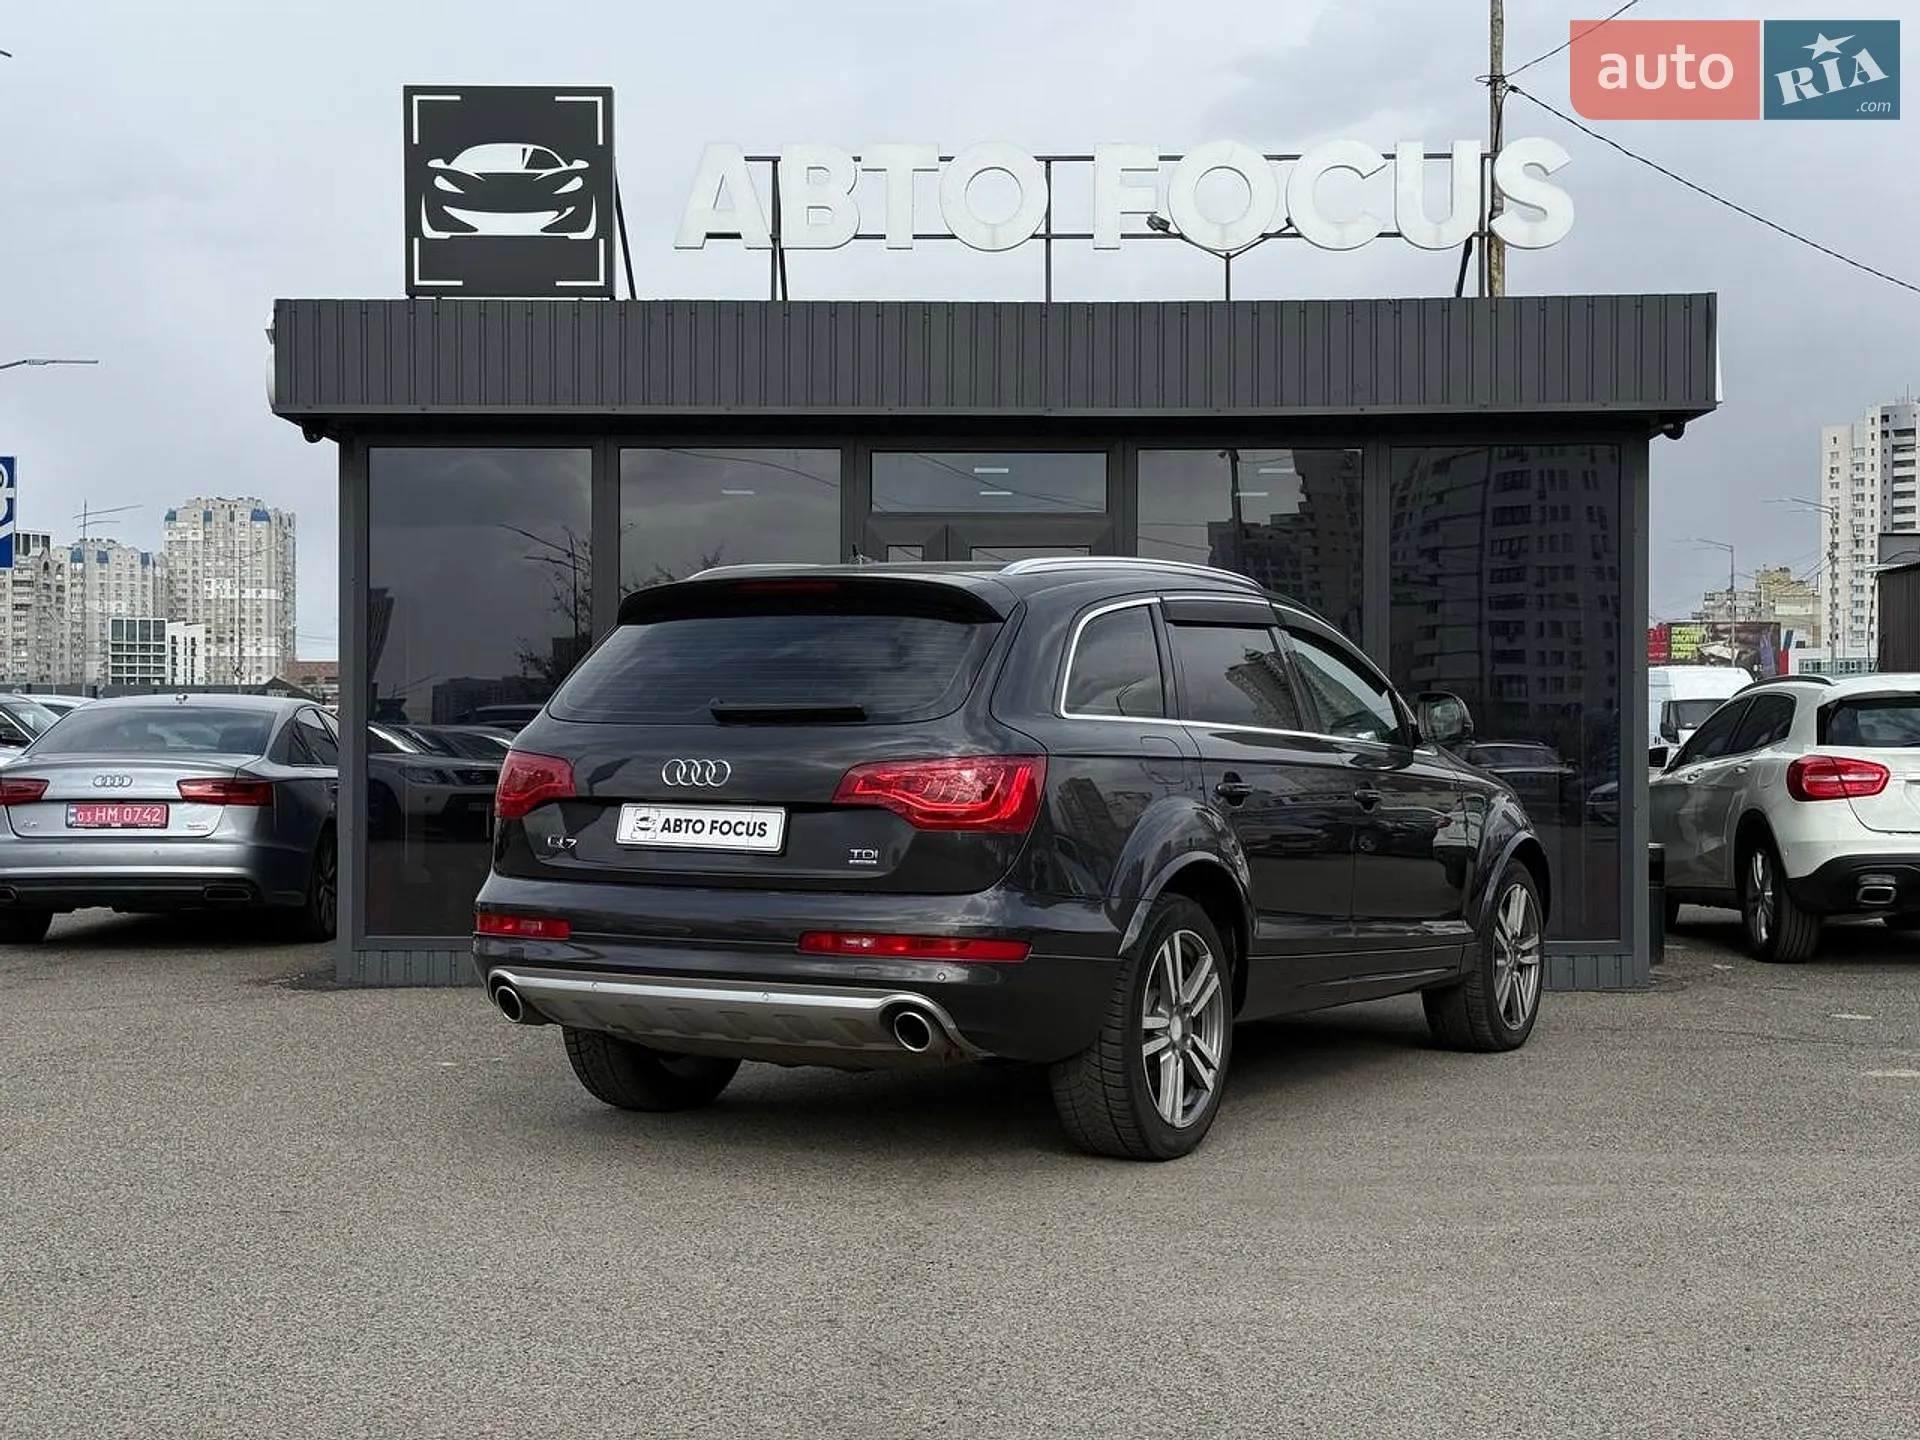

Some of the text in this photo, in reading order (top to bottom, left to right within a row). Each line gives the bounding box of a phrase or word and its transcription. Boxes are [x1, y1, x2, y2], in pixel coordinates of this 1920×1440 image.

[674, 136, 1575, 252] АВТО FOCUS
[123, 807, 161, 822] 0742
[660, 817, 768, 838] АВТО FOCUS
[849, 849, 879, 859] TDI
